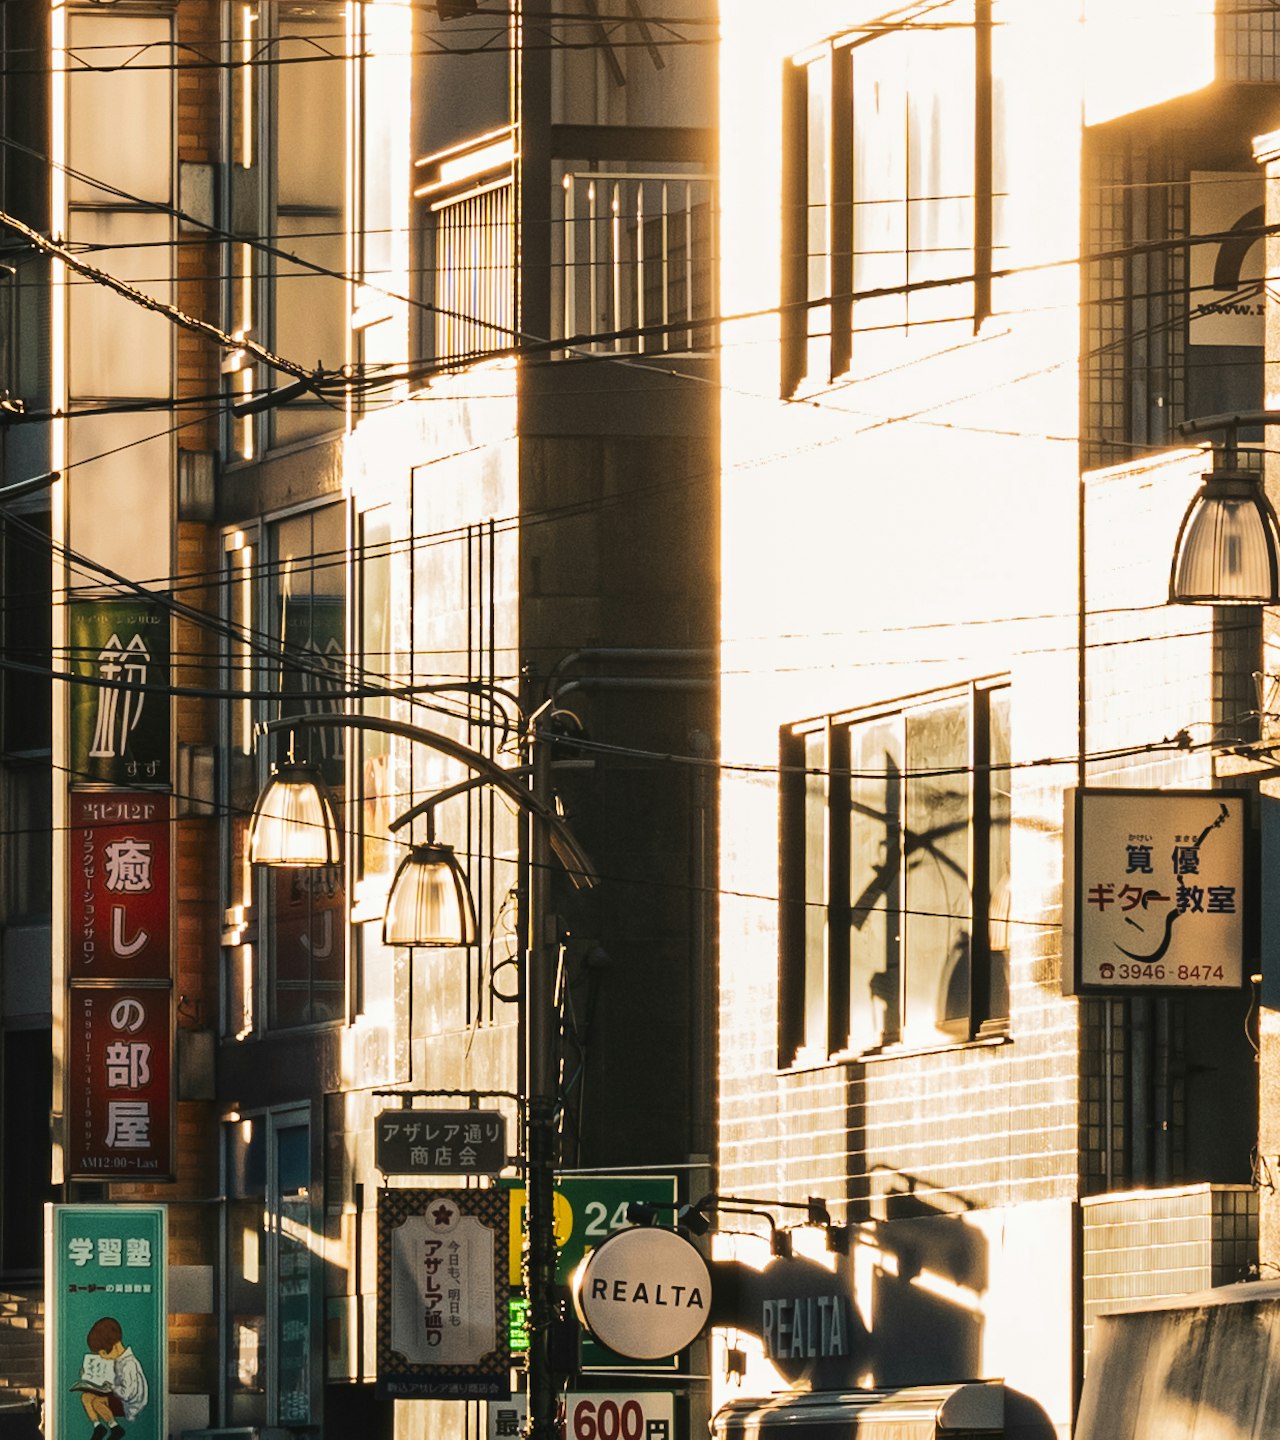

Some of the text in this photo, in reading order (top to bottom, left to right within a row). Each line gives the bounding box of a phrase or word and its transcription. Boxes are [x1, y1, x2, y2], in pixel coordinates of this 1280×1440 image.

[1088, 883, 1236, 913] ギター教室
[1119, 964, 1224, 980] 3946-8474
[383, 1123, 500, 1144] アザレア通り
[410, 1146, 478, 1166] 商店会
[69, 1238, 151, 1267] 学習塾
[424, 1239, 443, 1346] アザレア通り
[592, 1278, 704, 1309] REALTA
[763, 1296, 844, 1359] REALTA
